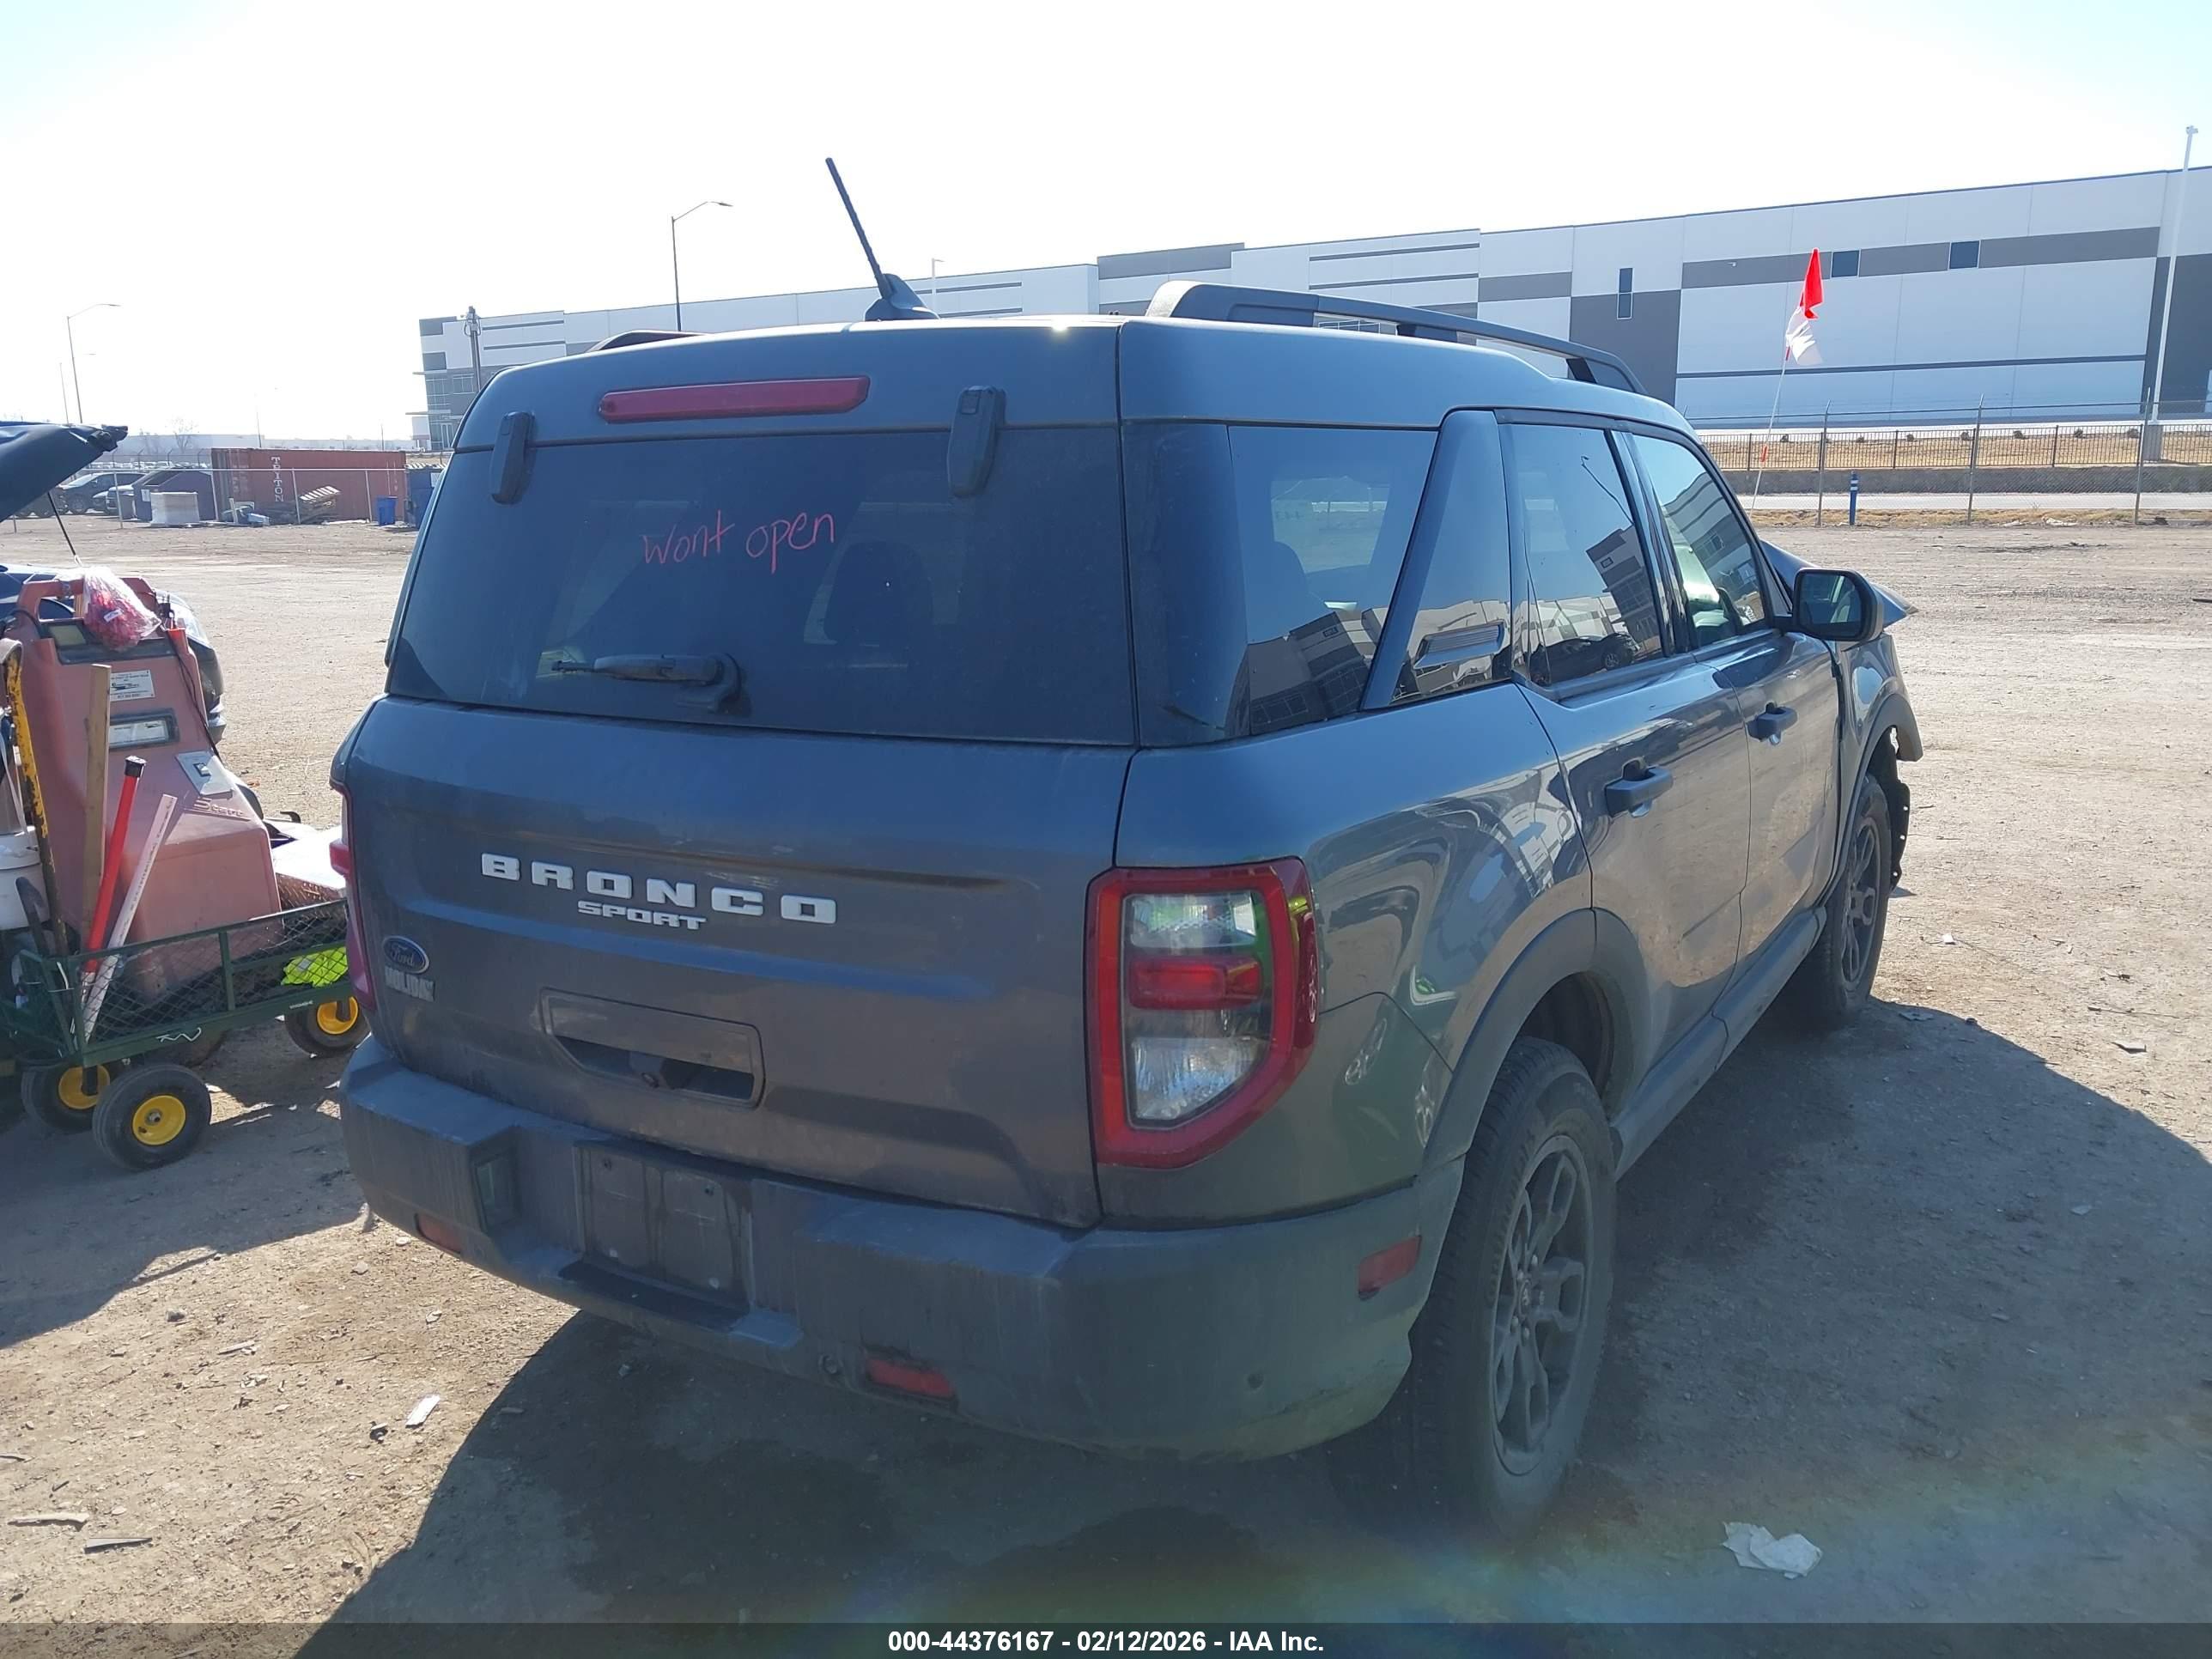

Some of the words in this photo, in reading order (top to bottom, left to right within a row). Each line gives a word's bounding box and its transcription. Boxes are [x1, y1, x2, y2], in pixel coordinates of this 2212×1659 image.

[270, 456, 284, 501] TRITON
[746, 512, 836, 574] open
[481, 853, 837, 925] BRONCO
[577, 899, 708, 930] SPORT
